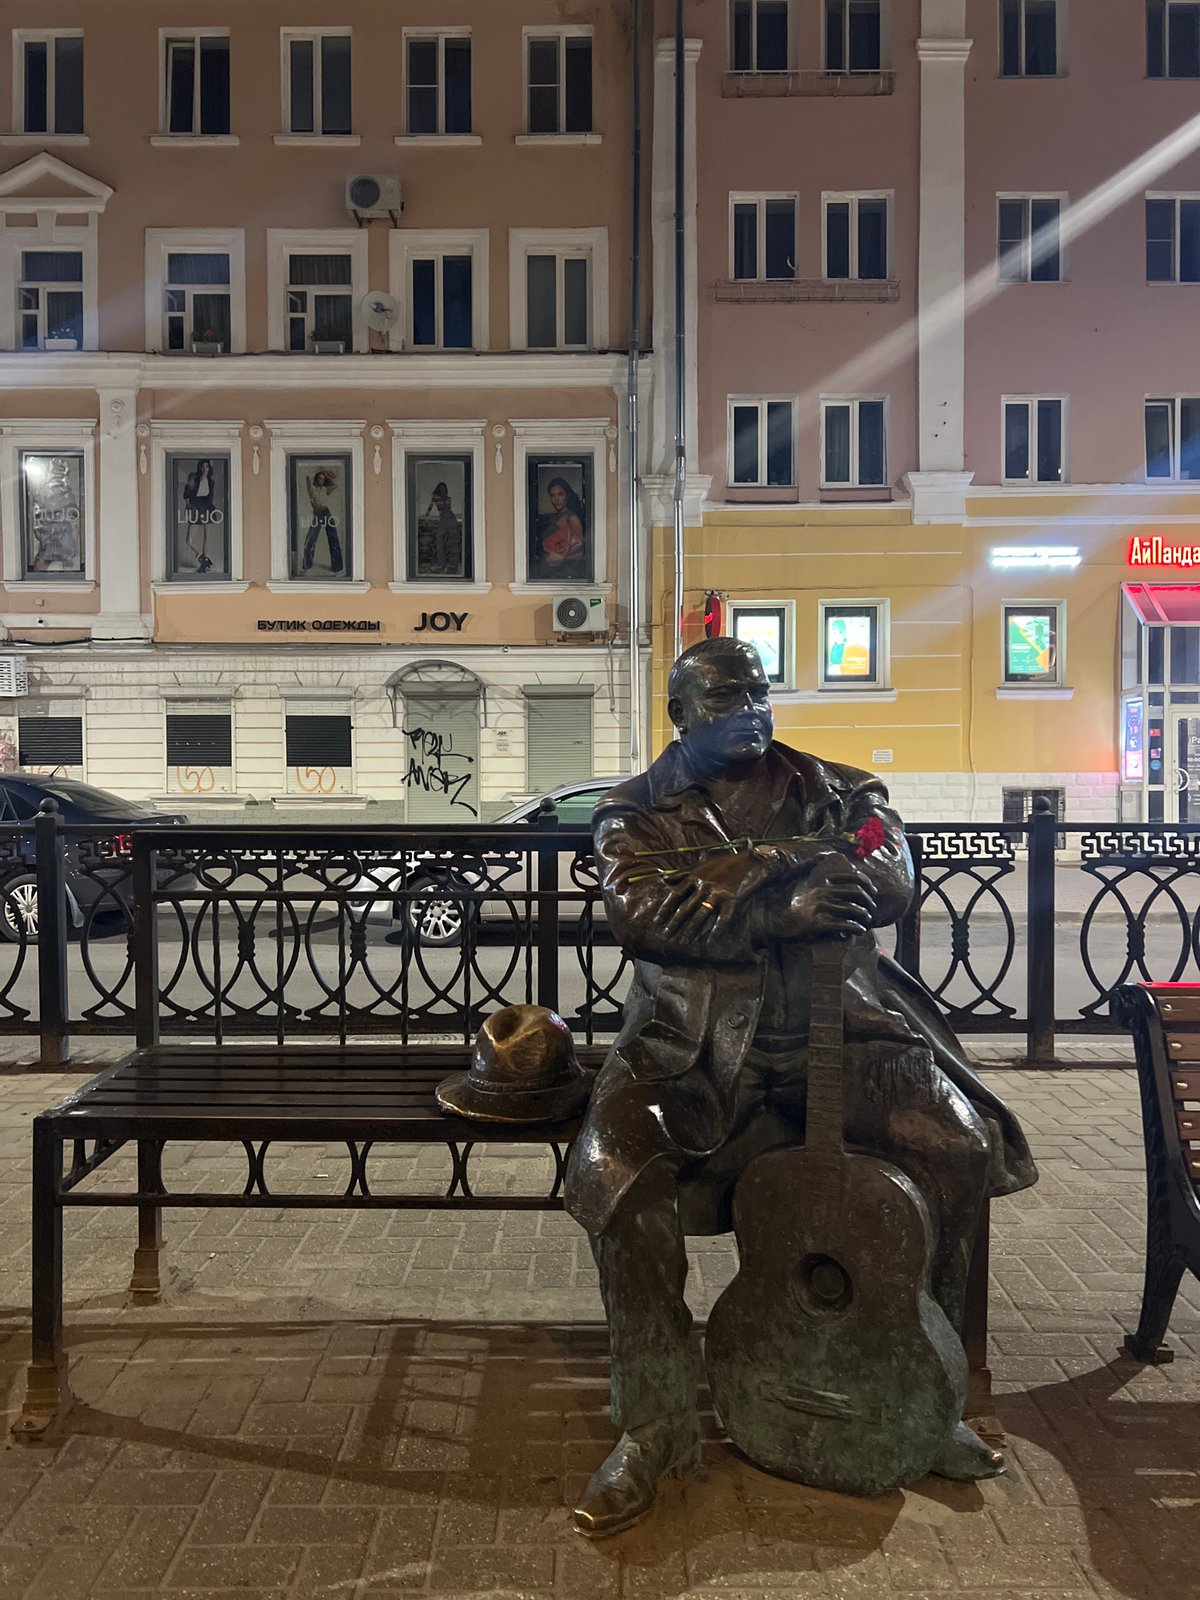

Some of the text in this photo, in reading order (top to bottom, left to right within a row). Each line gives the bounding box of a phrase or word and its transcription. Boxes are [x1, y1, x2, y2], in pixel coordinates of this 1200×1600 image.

[1130, 536, 1200, 567] АйПанда
[257, 620, 380, 631] БУТИК ОДЕЖДЫ
[414, 612, 469, 631] JOY
